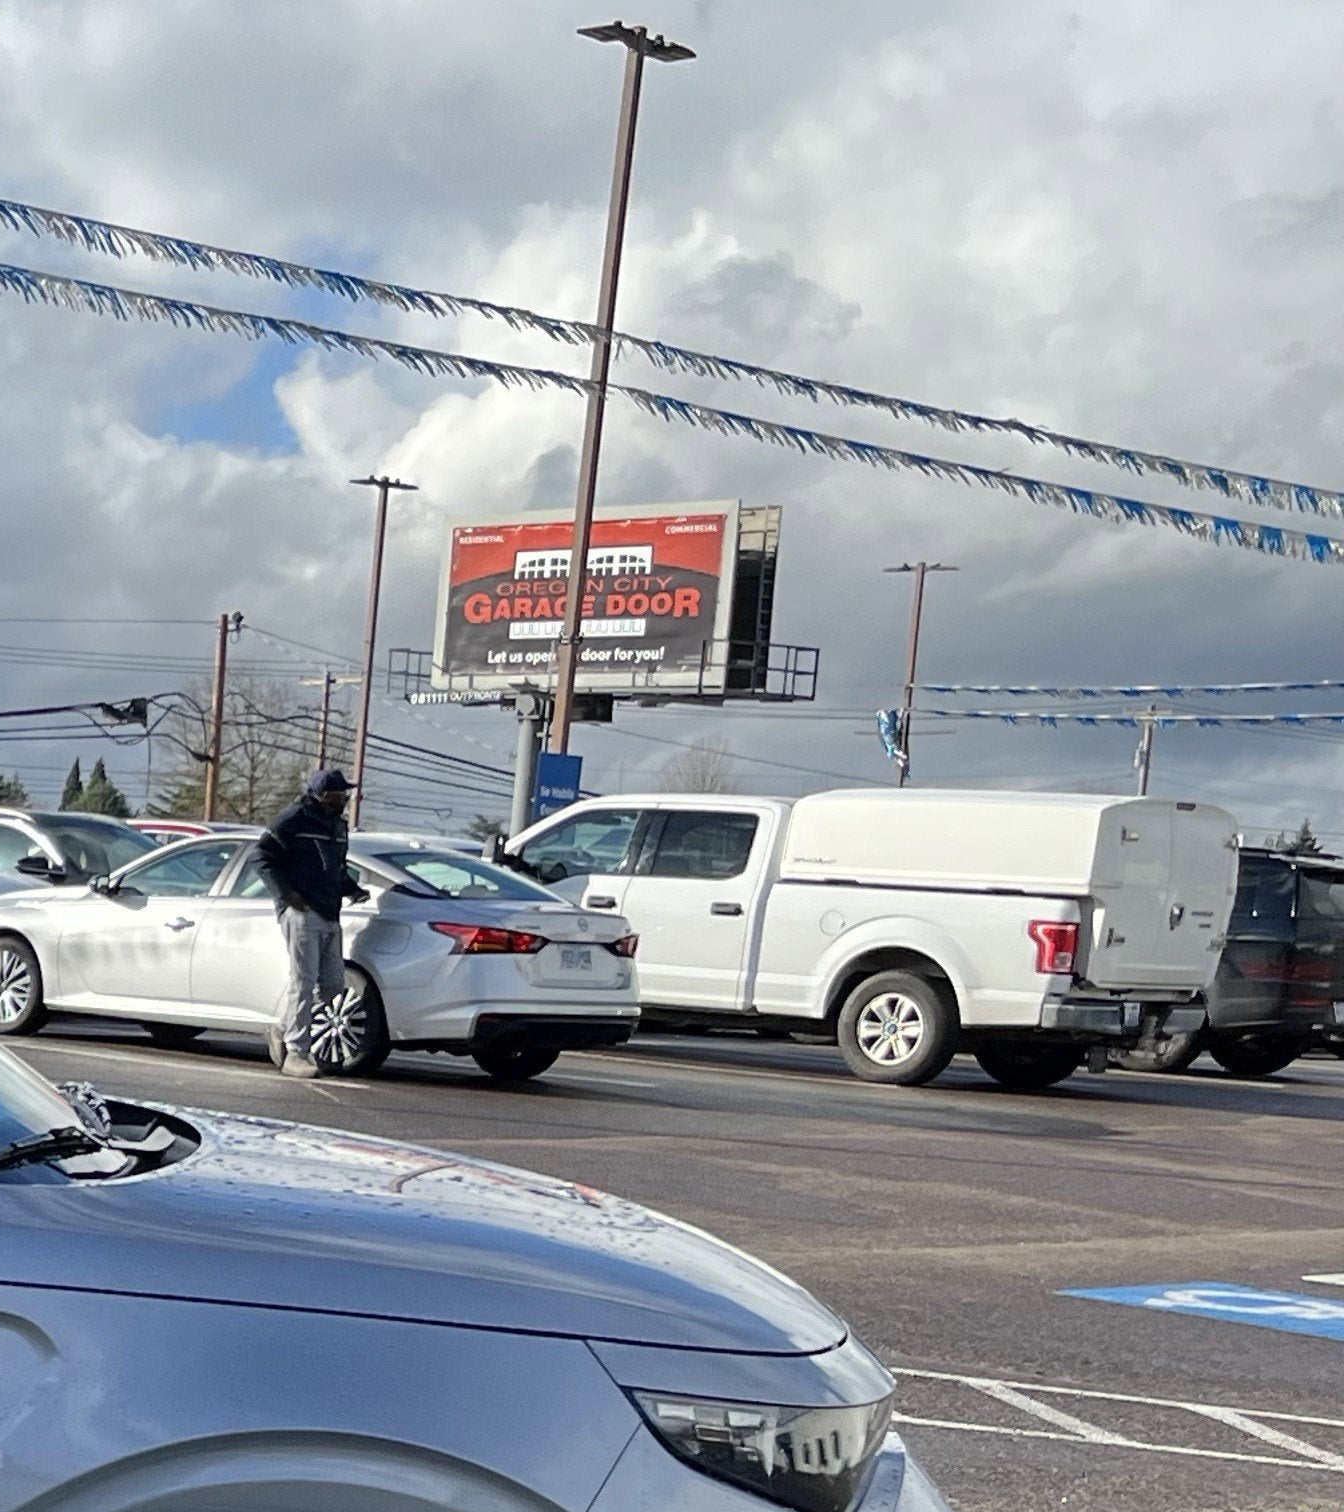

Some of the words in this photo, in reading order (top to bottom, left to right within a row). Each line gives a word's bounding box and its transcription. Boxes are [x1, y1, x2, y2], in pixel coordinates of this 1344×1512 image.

[496, 579, 604, 597] OREGN
[614, 576, 673, 592] CITY
[605, 587, 701, 618] DOOR
[488, 650, 507, 664] Let
[509, 652, 523, 663] us
[580, 648, 612, 661] door
[614, 647, 633, 661] for
[634, 646, 665, 664] you!
